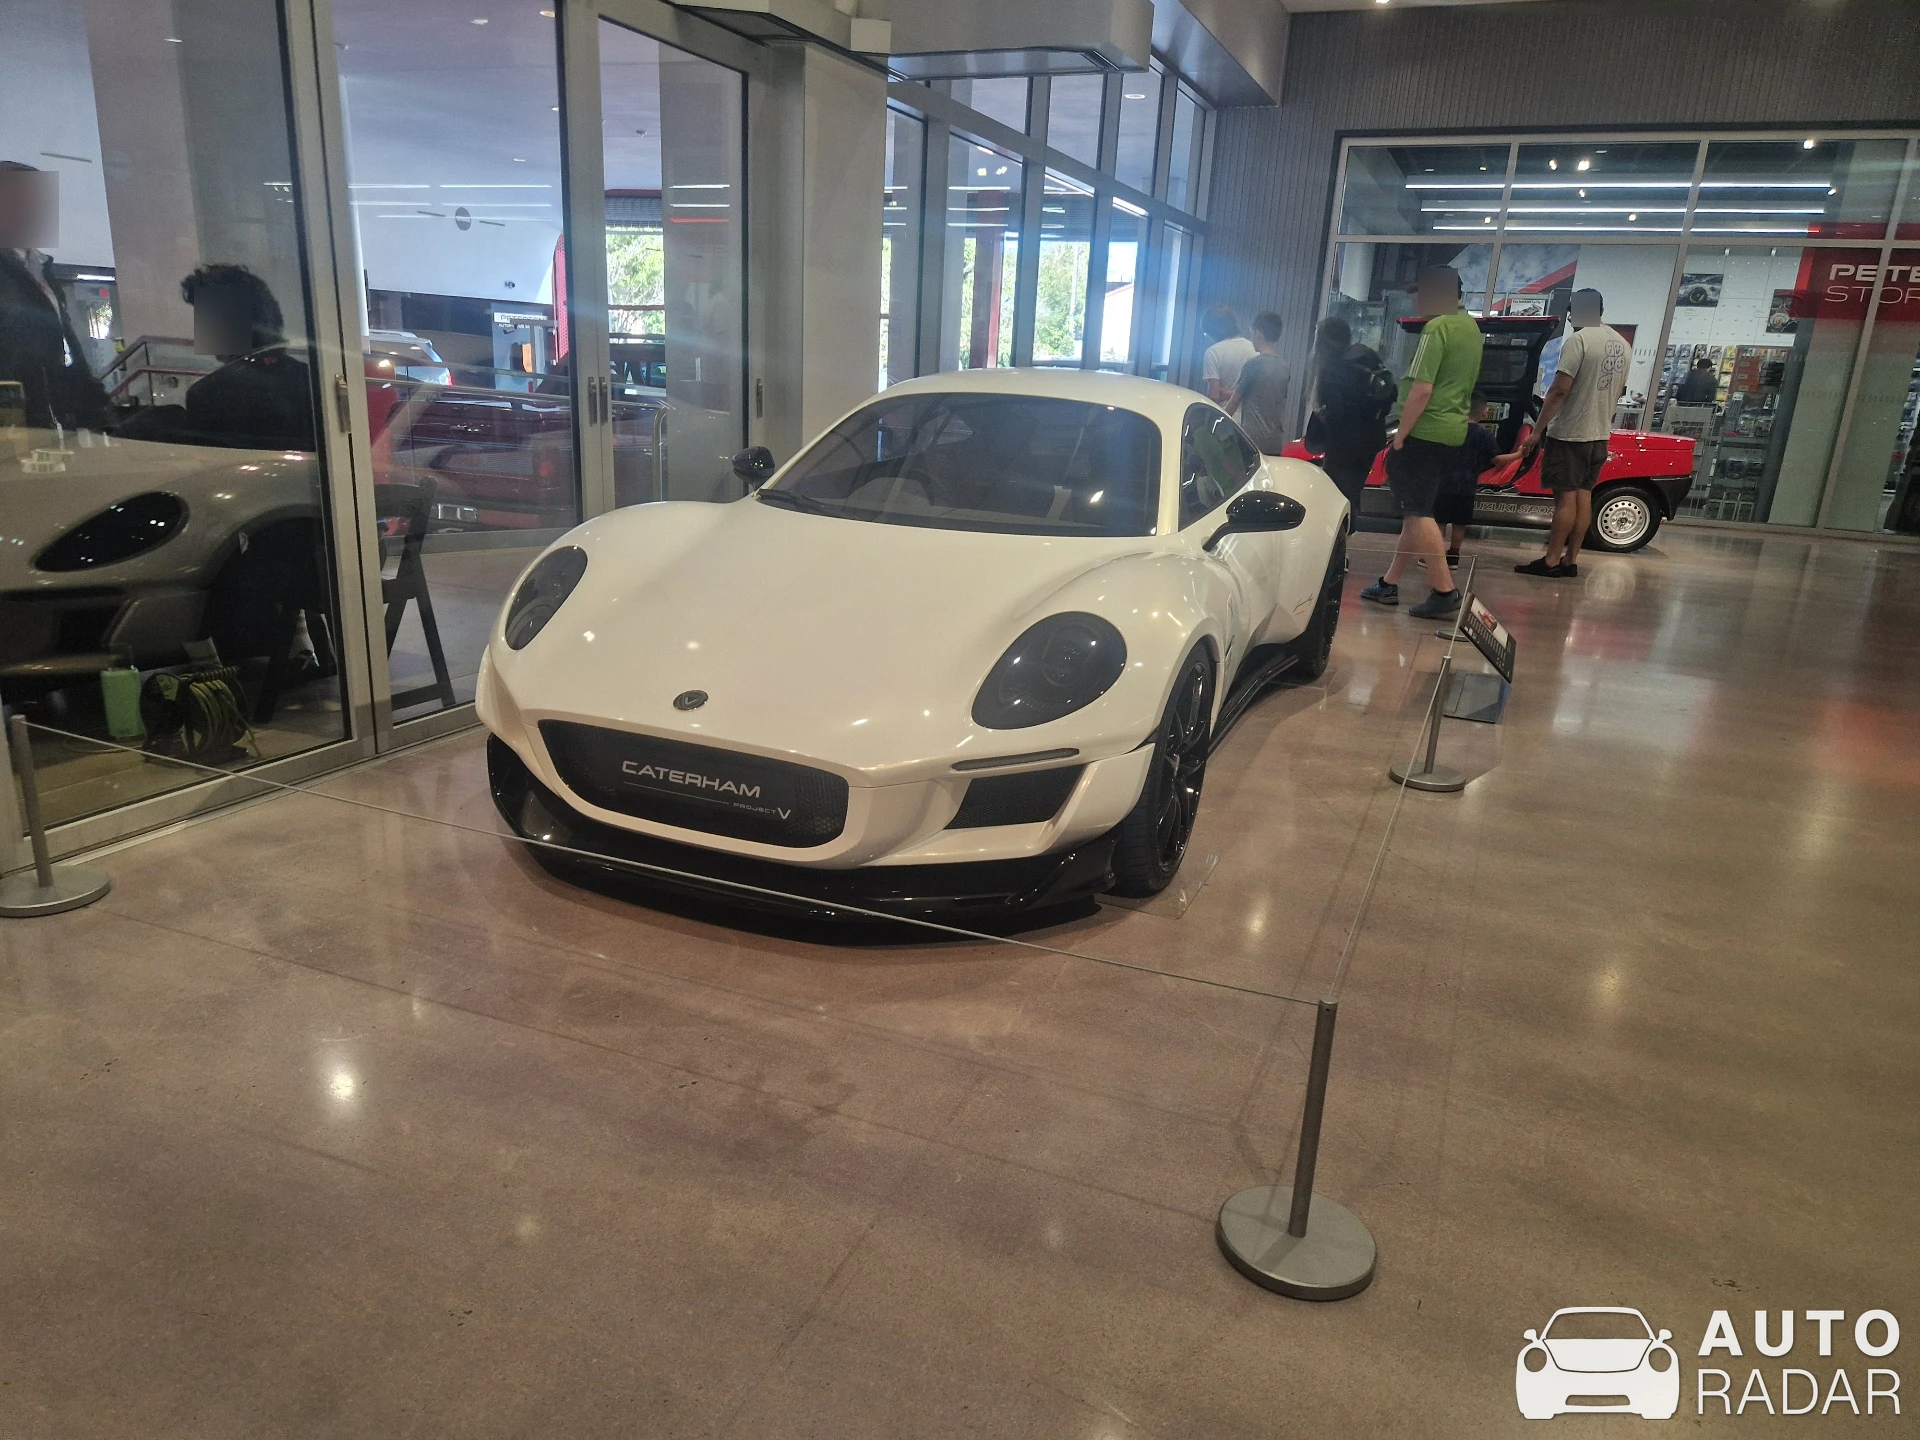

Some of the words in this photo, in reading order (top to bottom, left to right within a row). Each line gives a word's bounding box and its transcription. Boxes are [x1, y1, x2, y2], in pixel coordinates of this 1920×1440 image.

[1473, 501, 1517, 513] UZUKI
[621, 760, 761, 798] CATERHAM
[733, 803, 776, 814] PROJECT
